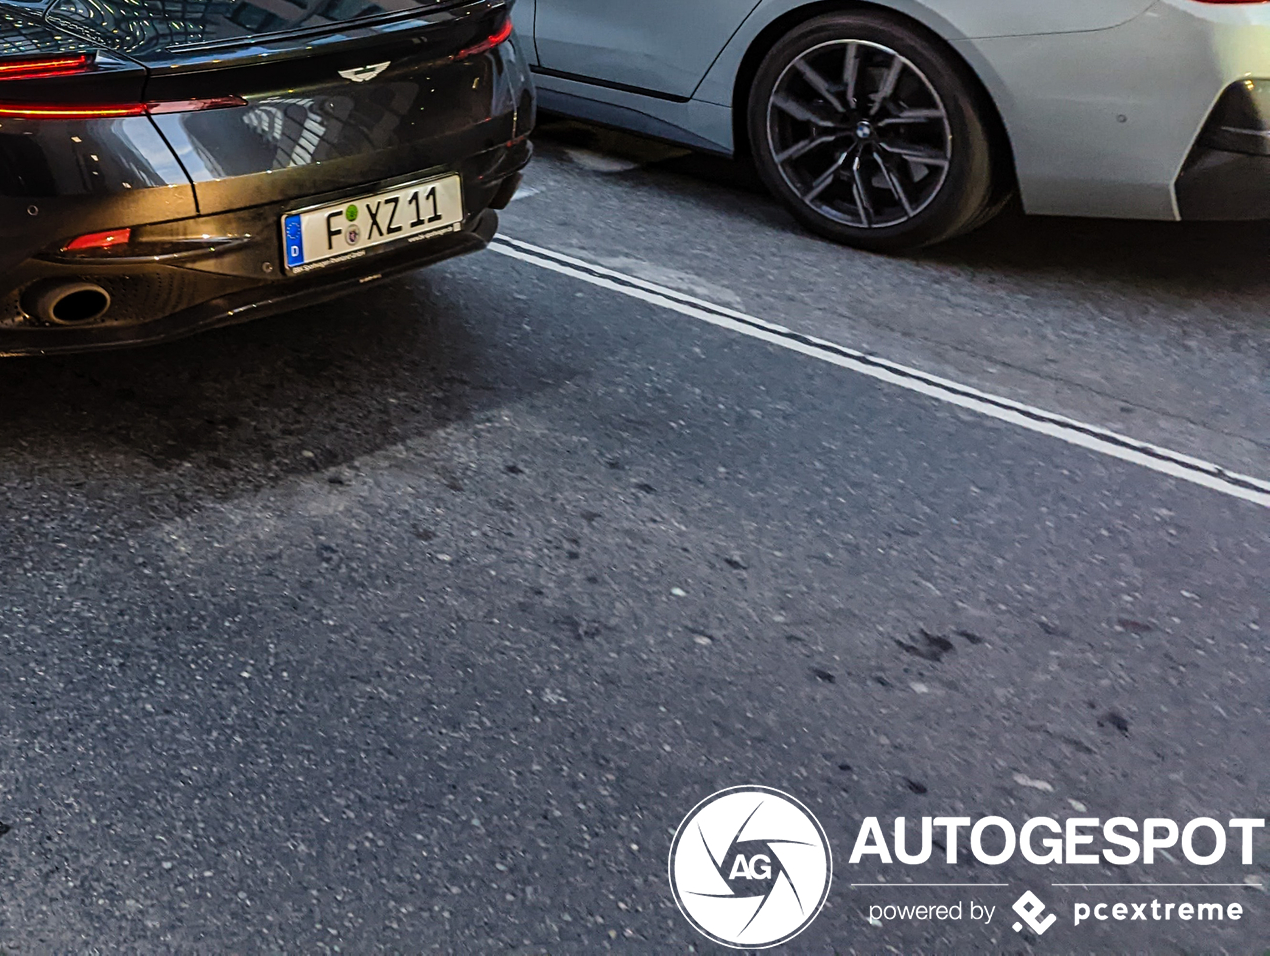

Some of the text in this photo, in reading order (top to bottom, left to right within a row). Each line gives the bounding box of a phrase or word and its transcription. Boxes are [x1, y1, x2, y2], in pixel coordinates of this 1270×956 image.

[326, 210, 343, 250] F
[365, 196, 403, 240] XZ
[408, 186, 442, 228] 11
[291, 245, 299, 257] D
